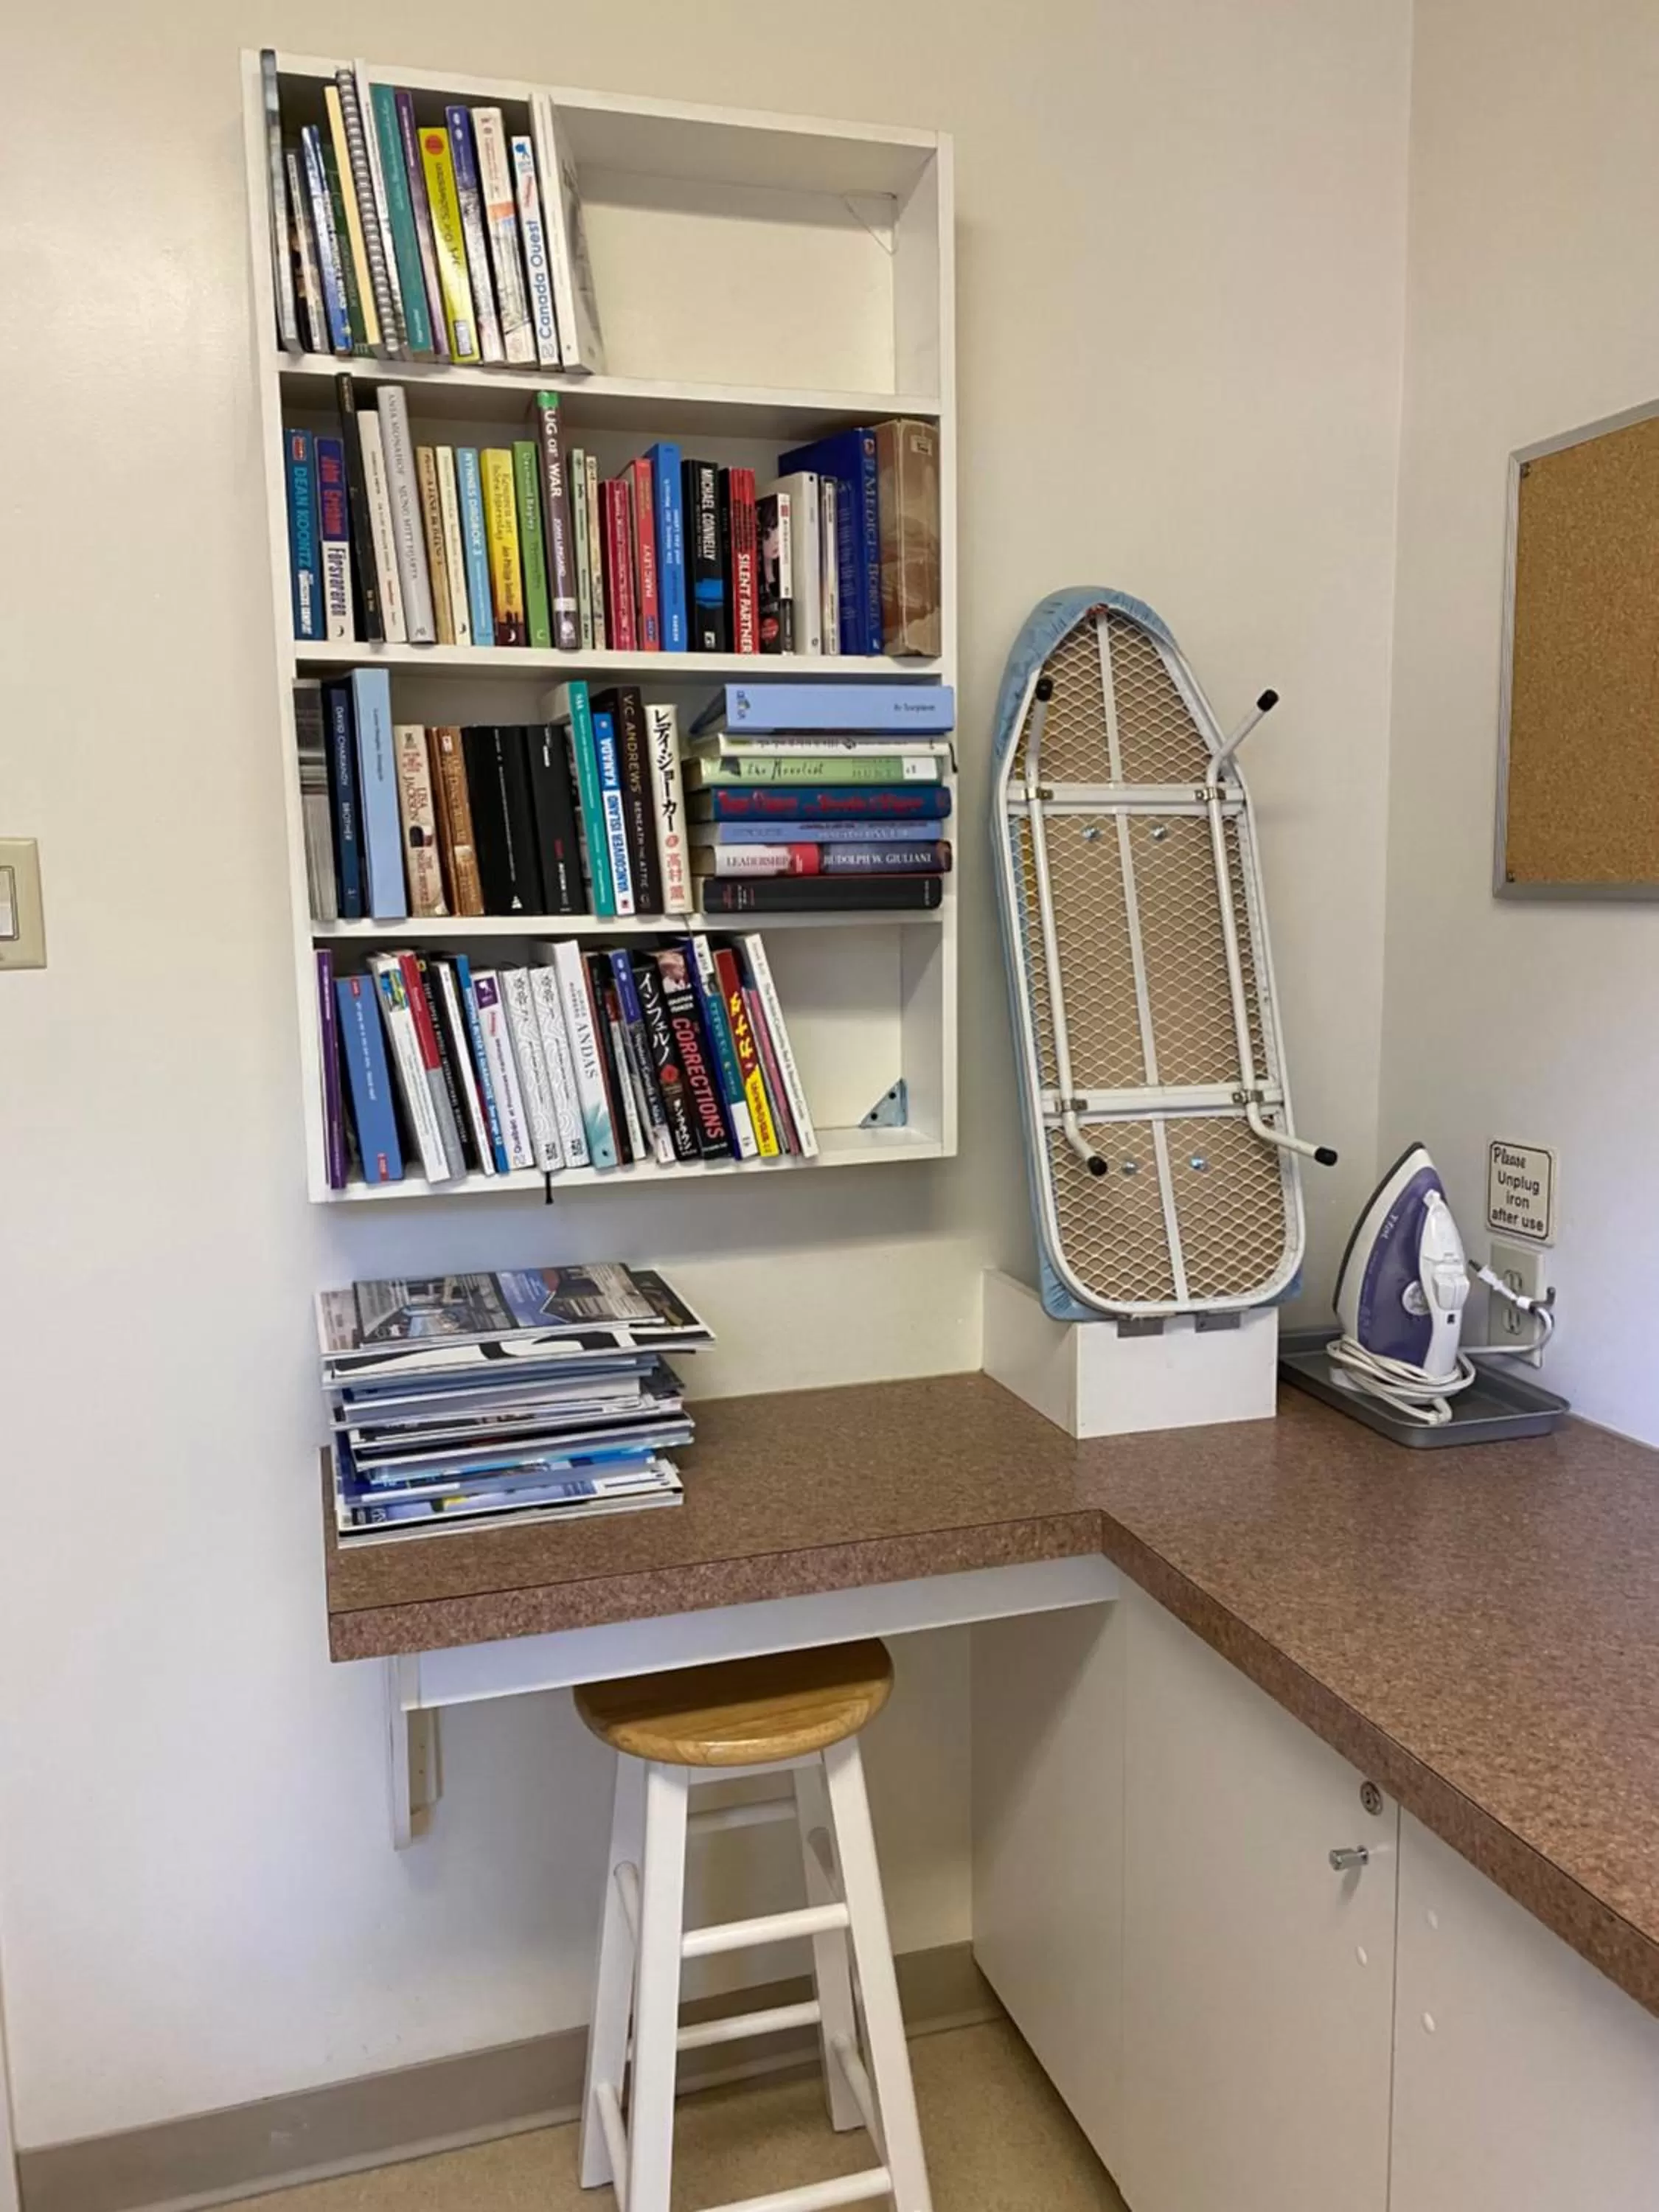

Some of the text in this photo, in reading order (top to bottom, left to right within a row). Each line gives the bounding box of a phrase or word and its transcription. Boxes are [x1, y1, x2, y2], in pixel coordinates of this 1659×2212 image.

[528, 220, 552, 339] Canada Ouest
[544, 406, 558, 435] UG
[294, 467, 310, 507] DEAN
[549, 462, 563, 498] WAR
[296, 509, 312, 567] KOONTZ
[700, 468, 717, 560] MICHAEL CONNELLY
[641, 544, 653, 597] MARC LEVY
[738, 554, 751, 595] SILENT
[740, 599, 753, 653] PARTNER
[335, 705, 346, 733] DAVID
[341, 801, 352, 840] BROTHER
[600, 738, 628, 894] VANCOUVER ISLAND KANADA
[625, 720, 641, 792] ANDREWS
[633, 799, 645, 844] BENEATH
[639, 860, 649, 887] ATTIC
[726, 857, 789, 867] LEADERSHIP
[824, 854, 870, 866] RUDOLPH
[886, 853, 932, 864] GIULIANI
[639, 973, 670, 1066] インフェルノ
[575, 1022, 597, 1079] ANDAS
[672, 1017, 728, 1138] CORRECTIONS
[1493, 1146, 1526, 1169] Please
[1498, 1170, 1540, 1196] Unplug
[1492, 1208, 1544, 1232] after use
[1506, 1189, 1530, 1209] iron
